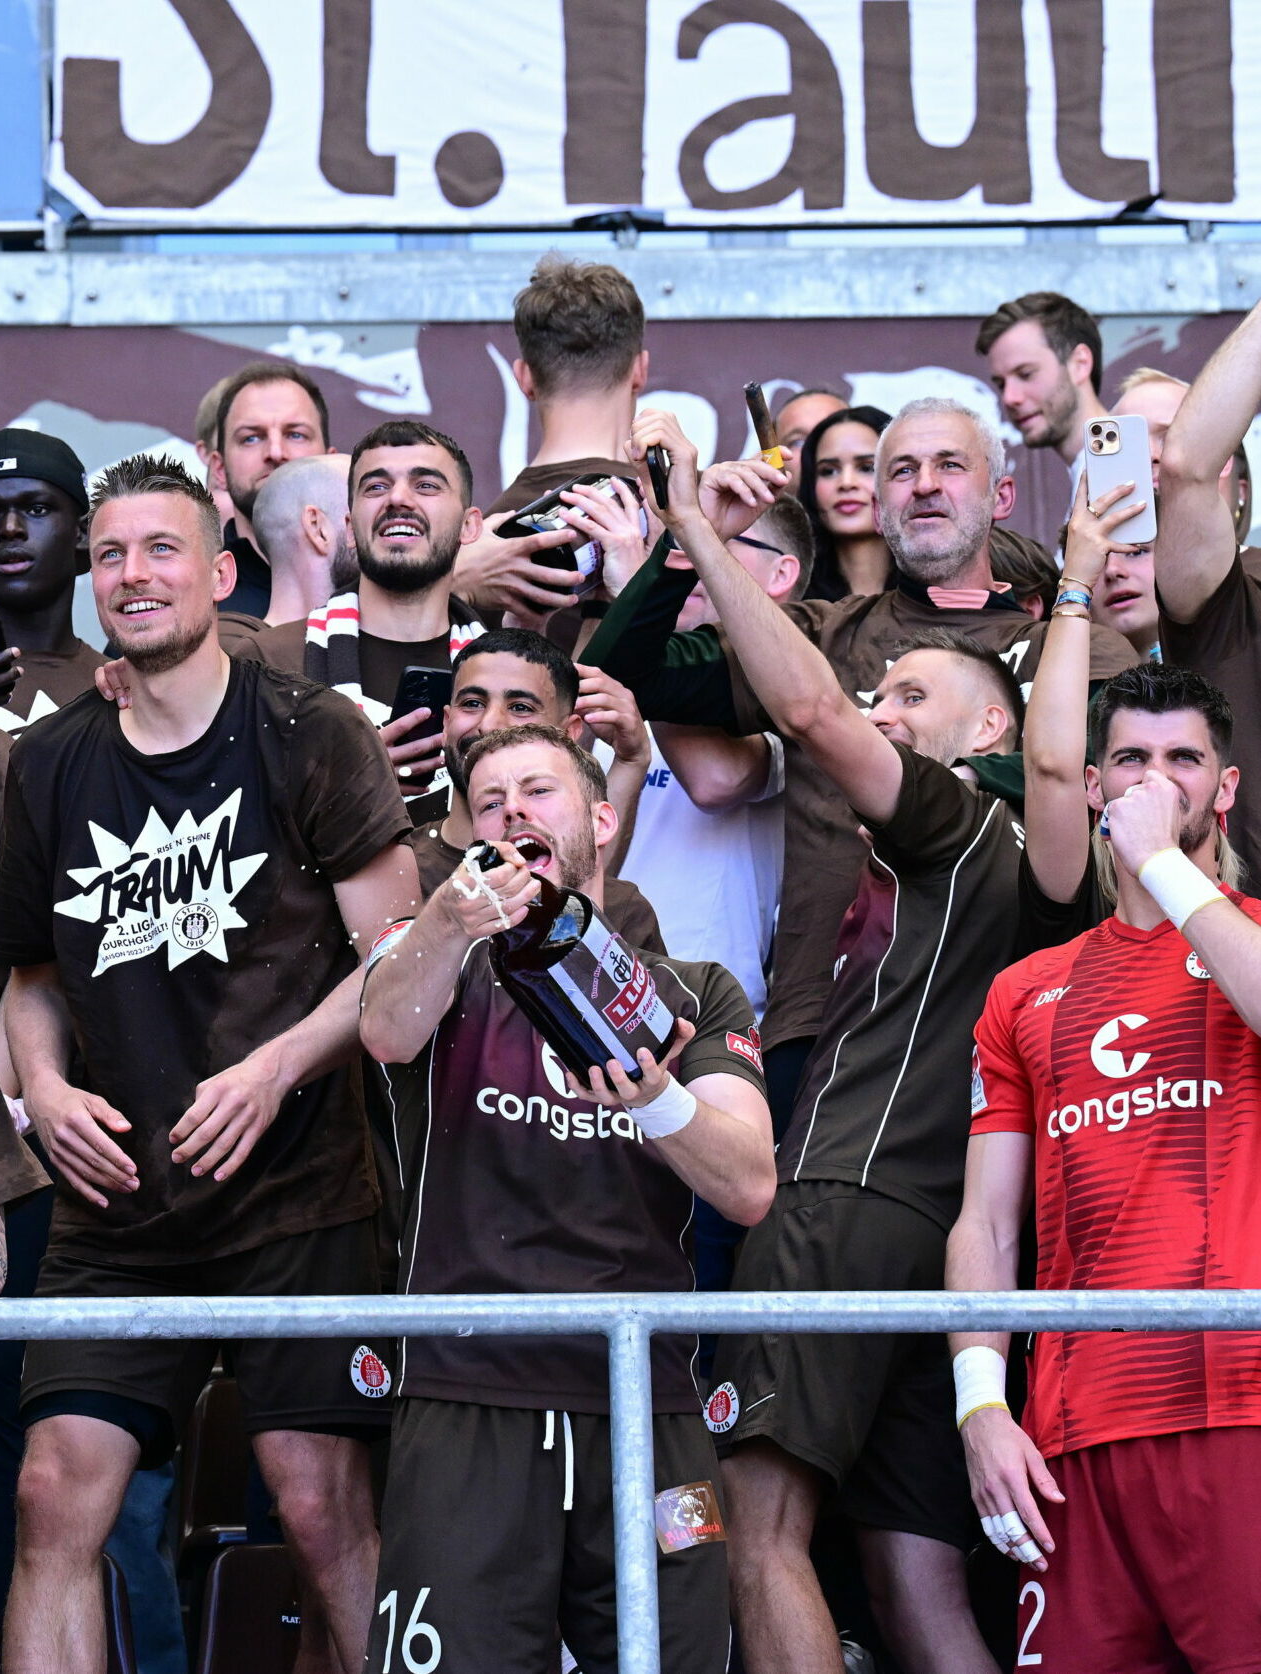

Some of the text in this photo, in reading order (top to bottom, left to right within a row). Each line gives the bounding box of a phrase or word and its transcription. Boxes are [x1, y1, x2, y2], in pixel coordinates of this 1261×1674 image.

[156, 844, 173, 855] RISE
[187, 832, 211, 843] SHINE
[82, 815, 233, 924] TRAUM
[174, 915, 183, 926] FC
[196, 905, 215, 924] PAULI
[102, 922, 169, 951] DURCHGESPIELT!
[116, 917, 155, 937] 2. LIGA
[186, 939, 204, 948] 1910
[101, 951, 126, 963] SAISON
[625, 1015, 644, 1034] Was
[733, 1040, 763, 1072] AST
[1047, 1076, 1223, 1139] congstar
[353, 1357, 360, 1369] FC
[365, 1387, 384, 1397] 1910
[713, 1421, 730, 1431] 1910
[378, 1587, 442, 1674] 16
[1018, 1581, 1045, 1666] 2
